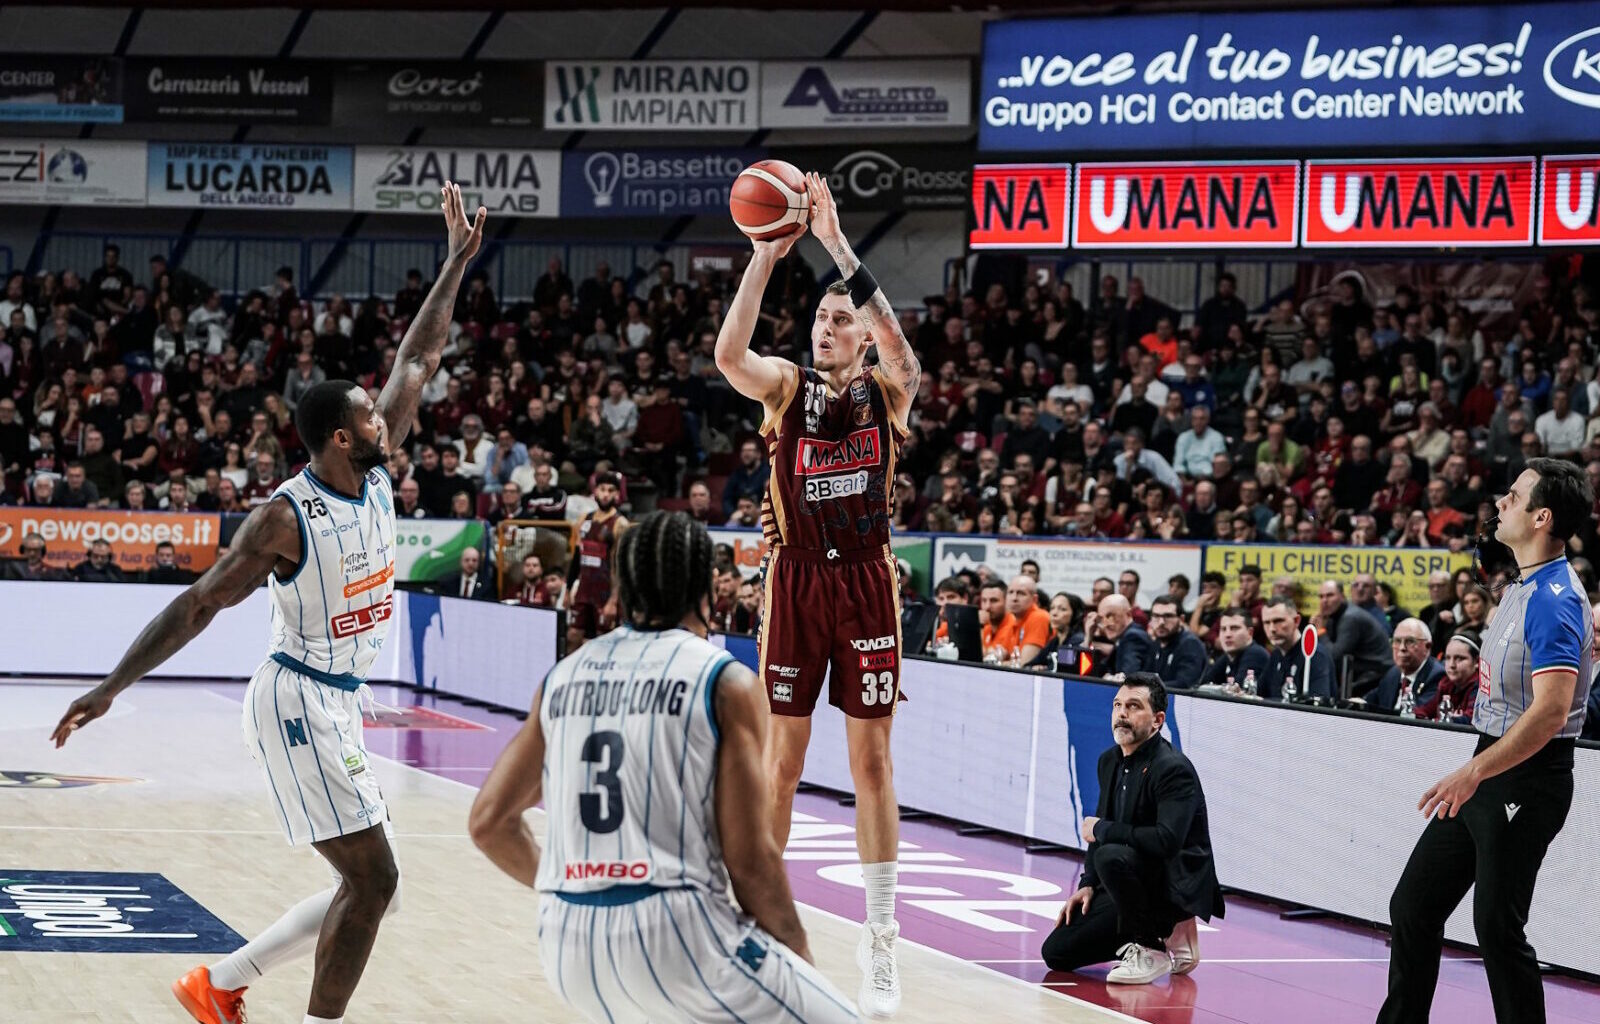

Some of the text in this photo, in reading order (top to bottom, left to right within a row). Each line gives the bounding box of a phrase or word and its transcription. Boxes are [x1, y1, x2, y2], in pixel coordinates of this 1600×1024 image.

[997, 21, 1533, 88] ...voce al tuo business!
[148, 67, 309, 95] Carrozzeria Vescovi
[612, 65, 749, 94] MIRANO
[782, 67, 936, 108] ANCILOTTO
[612, 99, 746, 125] IMPIANTI
[984, 82, 1525, 132] Gruppo HCI Contact Center Network
[167, 144, 329, 162] IMPRESE FUNEBRI
[623, 153, 744, 180] Bassetto
[165, 162, 333, 195] LUCARDA
[417, 151, 541, 189] ALMA
[200, 192, 295, 206] DELL'ANGELO
[375, 190, 539, 212] SPOTLAB
[623, 183, 730, 212] Impiant
[971, 178, 1050, 231] NA
[1089, 176, 1278, 234] UMANA
[1319, 174, 1516, 233] UMANA
[1556, 170, 1600, 230] U
[301, 496, 328, 520] 25
[1045, 550, 1117, 562] COSTRUZIONI
[1283, 553, 1405, 575] CHIESURA
[861, 671, 894, 706] 33
[579, 730, 625, 834] 3
[565, 862, 649, 880] KIMBO
